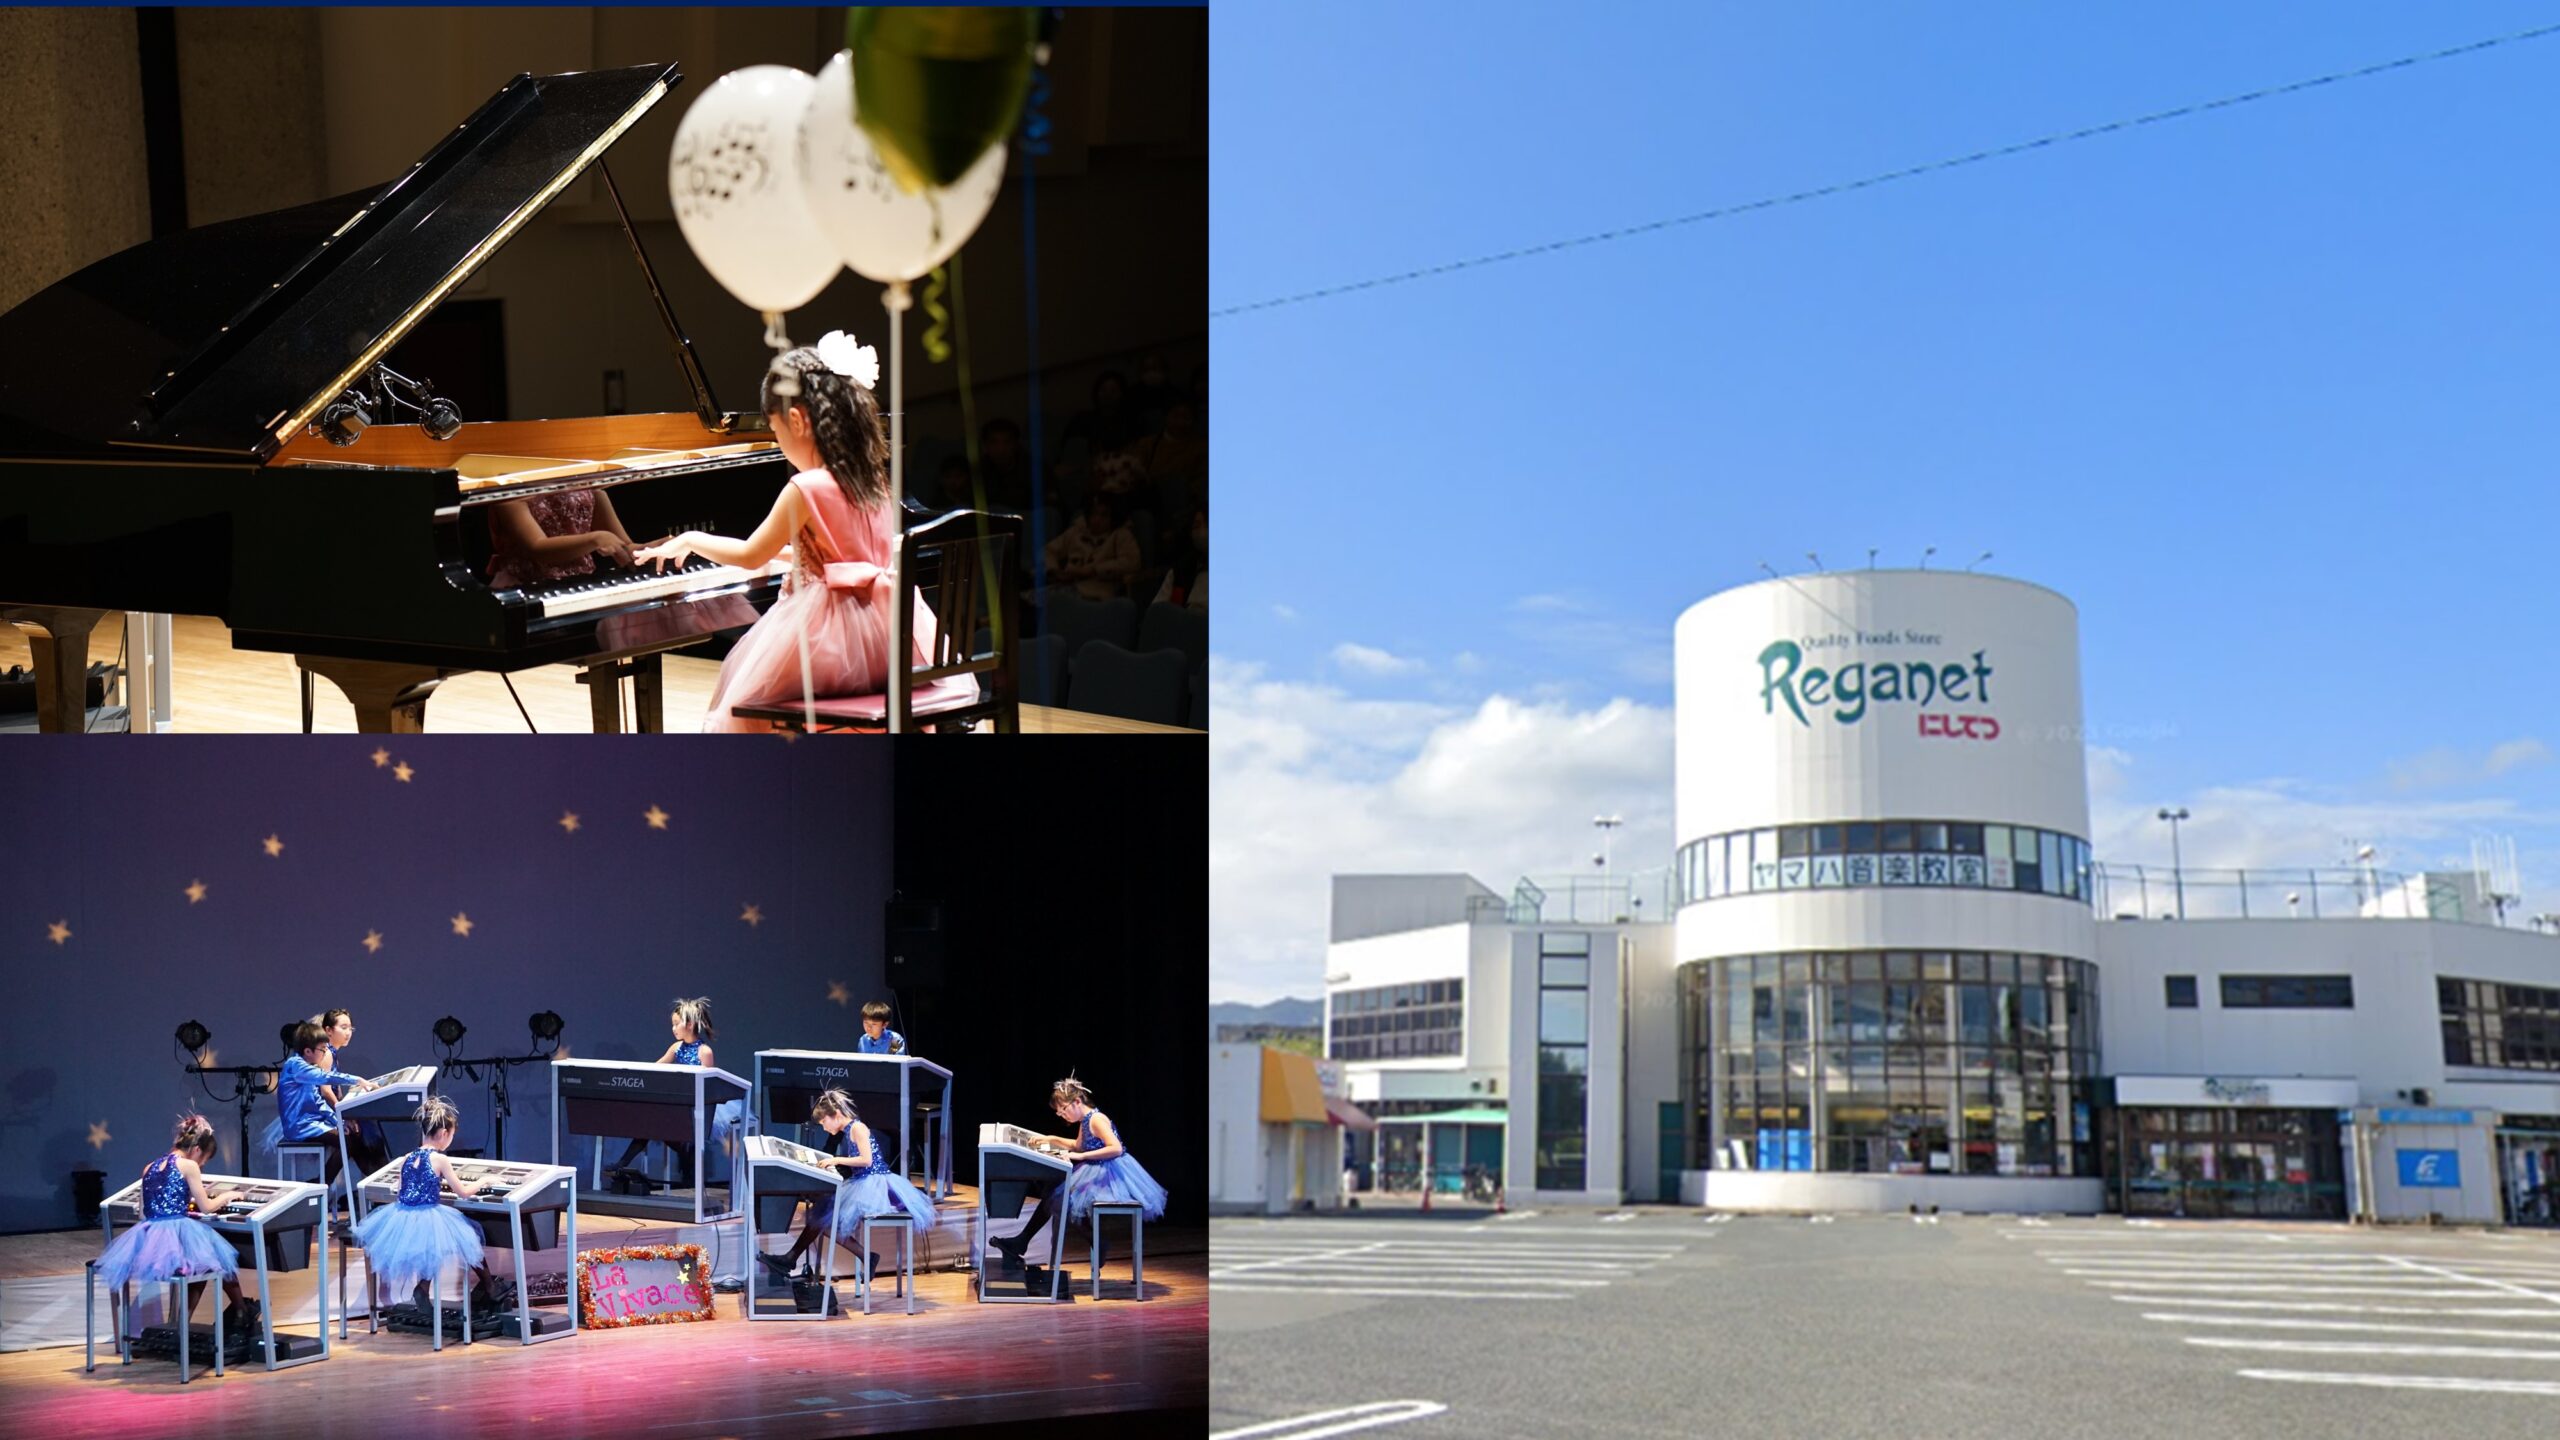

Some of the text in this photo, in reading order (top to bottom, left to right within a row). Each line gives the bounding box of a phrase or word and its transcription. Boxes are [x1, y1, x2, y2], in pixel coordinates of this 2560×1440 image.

[1801, 629, 1942, 650] Quality Foods Store
[1757, 639, 1993, 727] Reganet
[1918, 713, 2000, 740] にしてつ
[1755, 855, 1981, 886] ヤマハ音楽教室
[611, 1076, 645, 1088] STAGEA
[815, 1066, 849, 1078] STAGEA
[589, 1264, 629, 1292] La
[597, 1283, 701, 1319] Vivace
